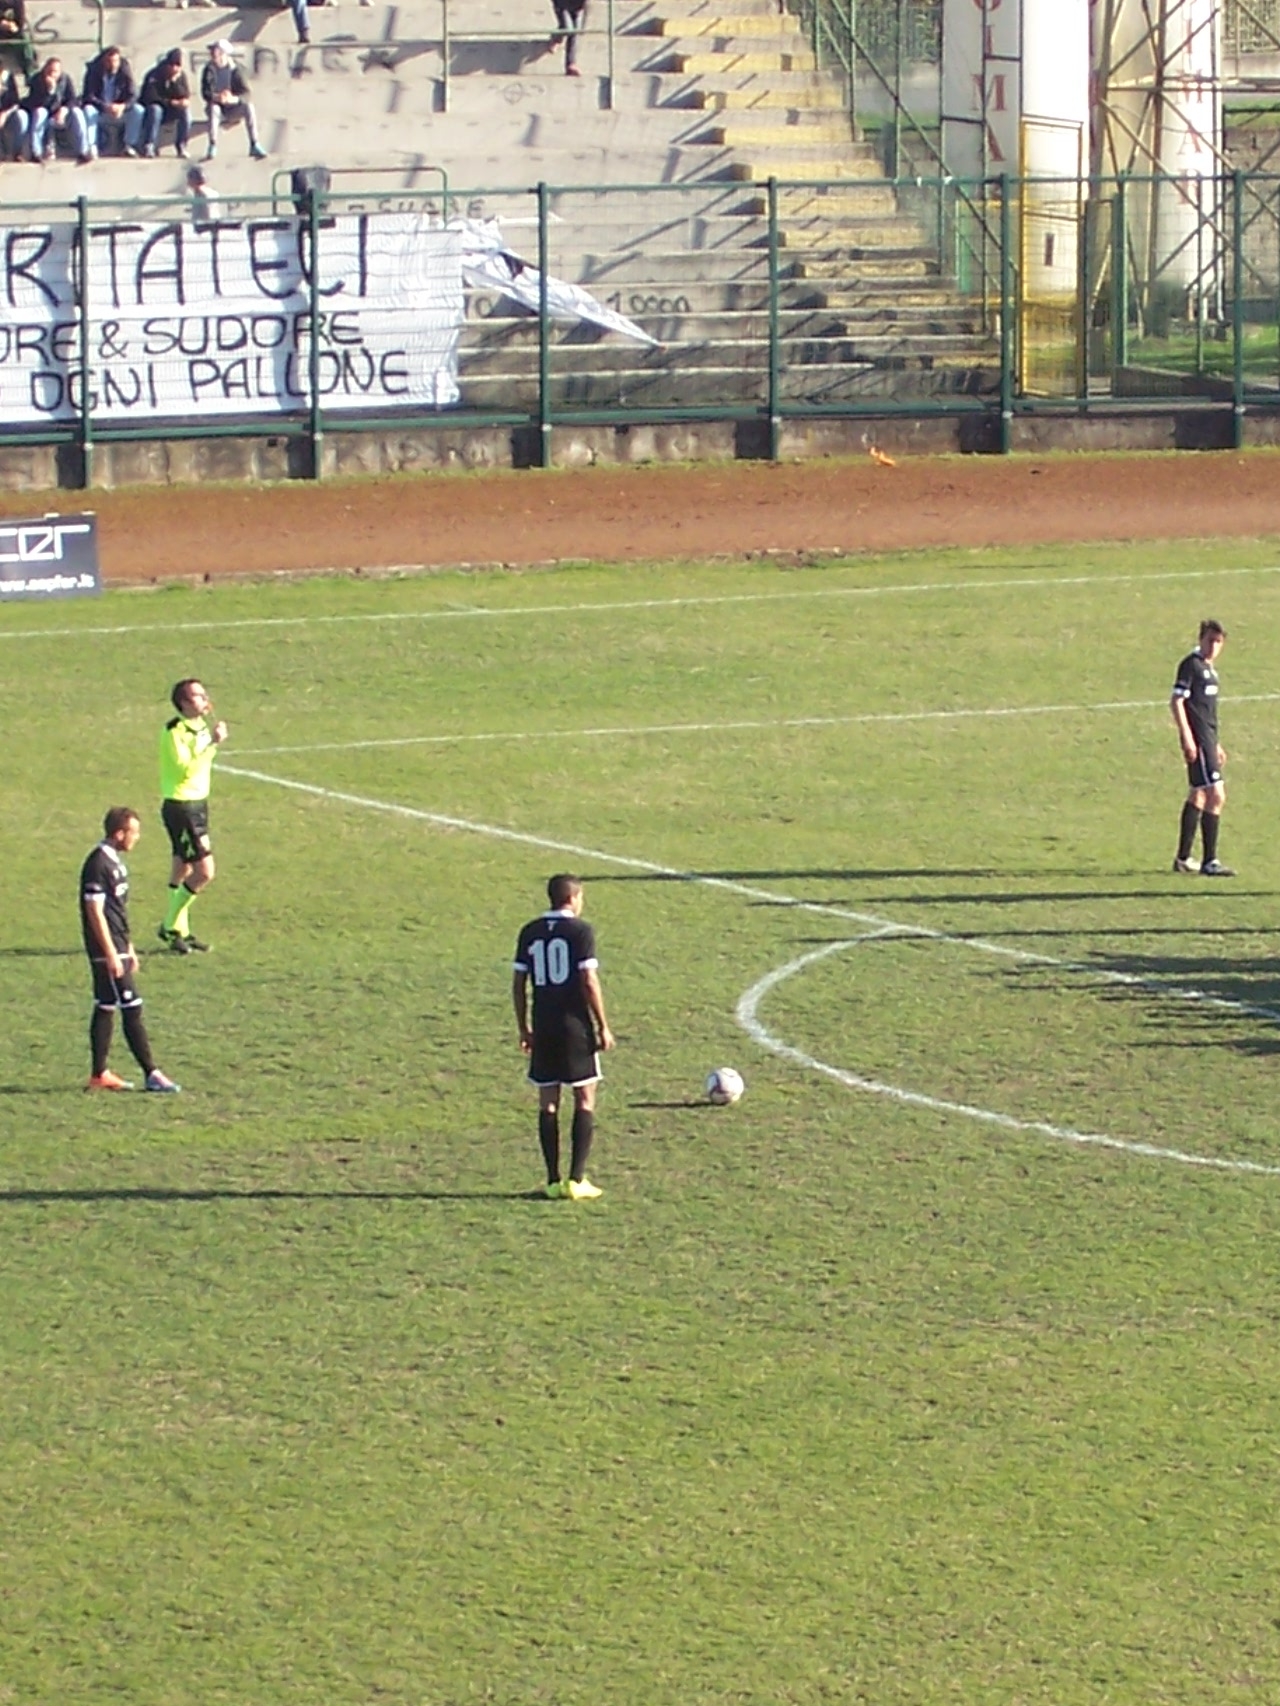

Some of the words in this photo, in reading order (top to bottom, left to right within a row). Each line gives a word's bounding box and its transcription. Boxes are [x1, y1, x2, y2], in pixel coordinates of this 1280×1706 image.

[99, 320, 128, 359] &
[143, 311, 364, 355] SUDORE
[31, 363, 157, 412] OGNI
[189, 347, 409, 401] PALLONE
[528, 937, 570, 986] 10
